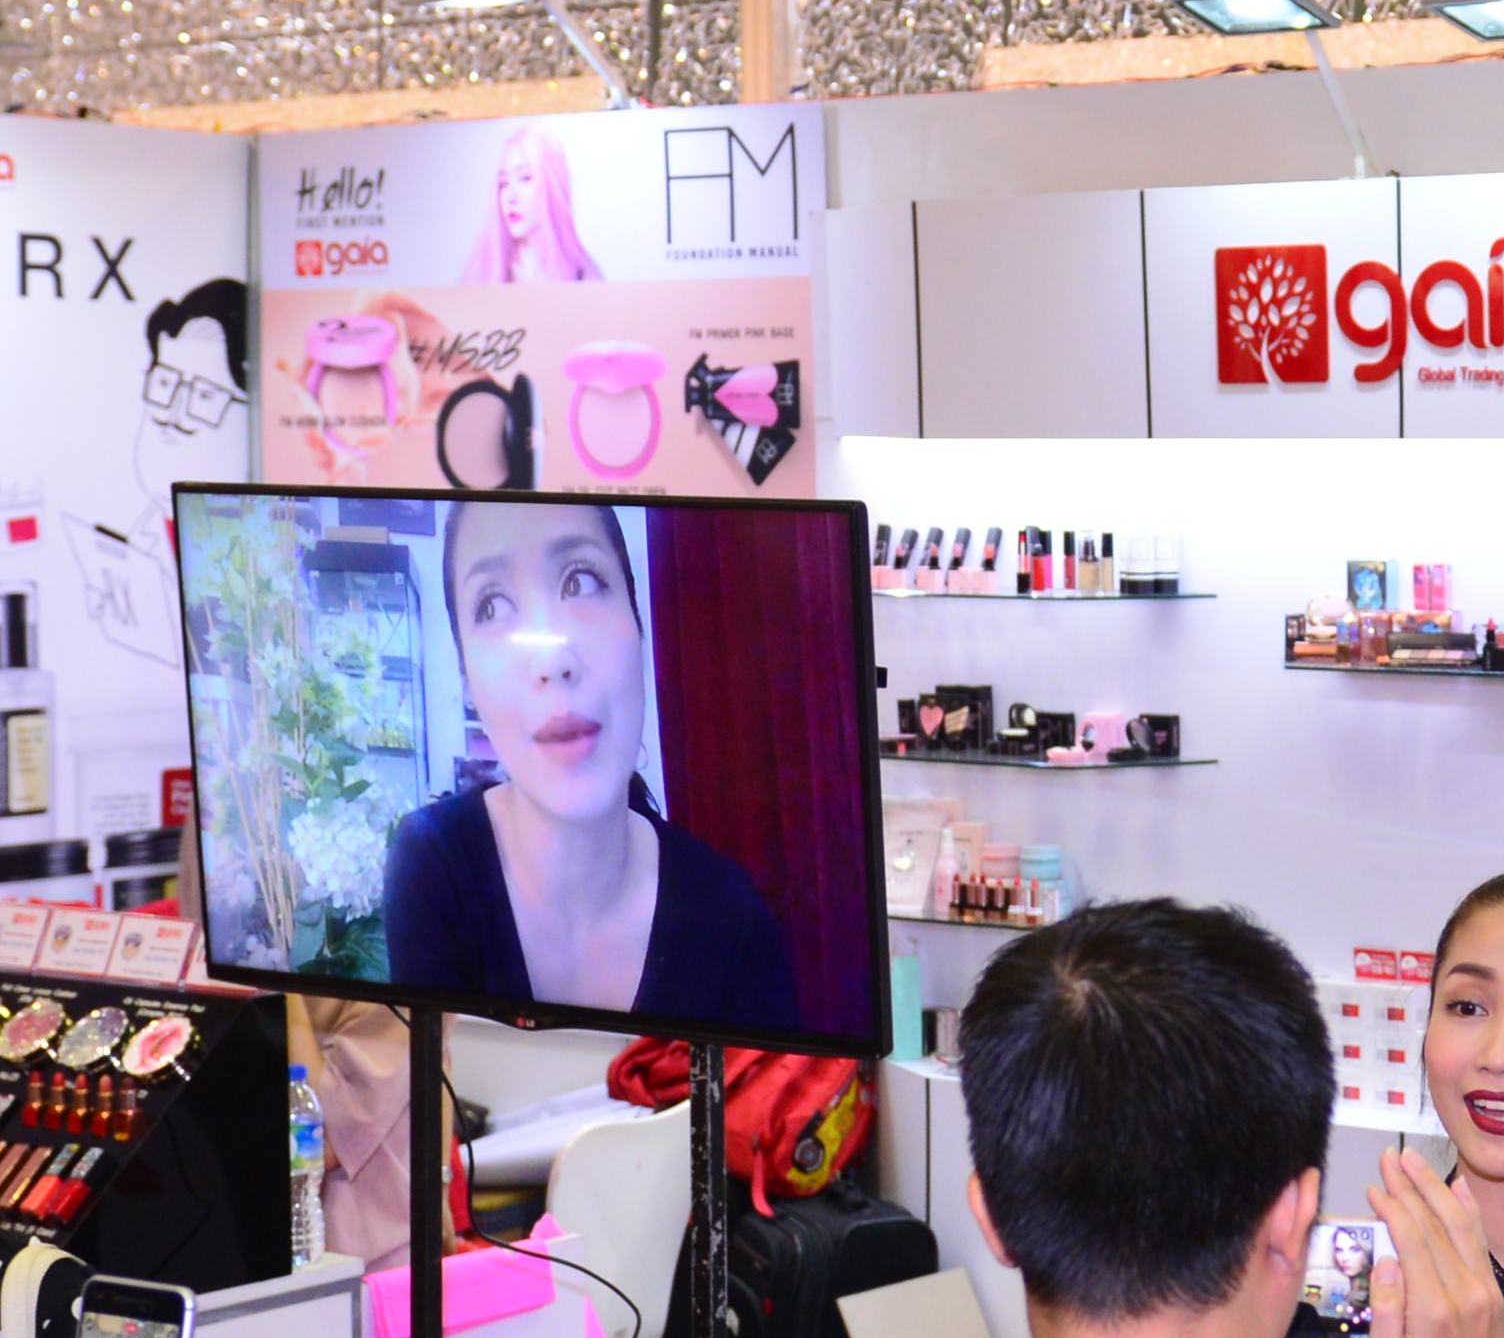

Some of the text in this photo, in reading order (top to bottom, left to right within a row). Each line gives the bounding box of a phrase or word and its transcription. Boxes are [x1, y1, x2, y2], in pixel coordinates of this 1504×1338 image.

[295, 166, 386, 213] Hello!
[665, 244, 799, 261] FOUNDATION MANUAL
[1418, 366, 1456, 382] Global
[1460, 365, 1504, 386] Trading
